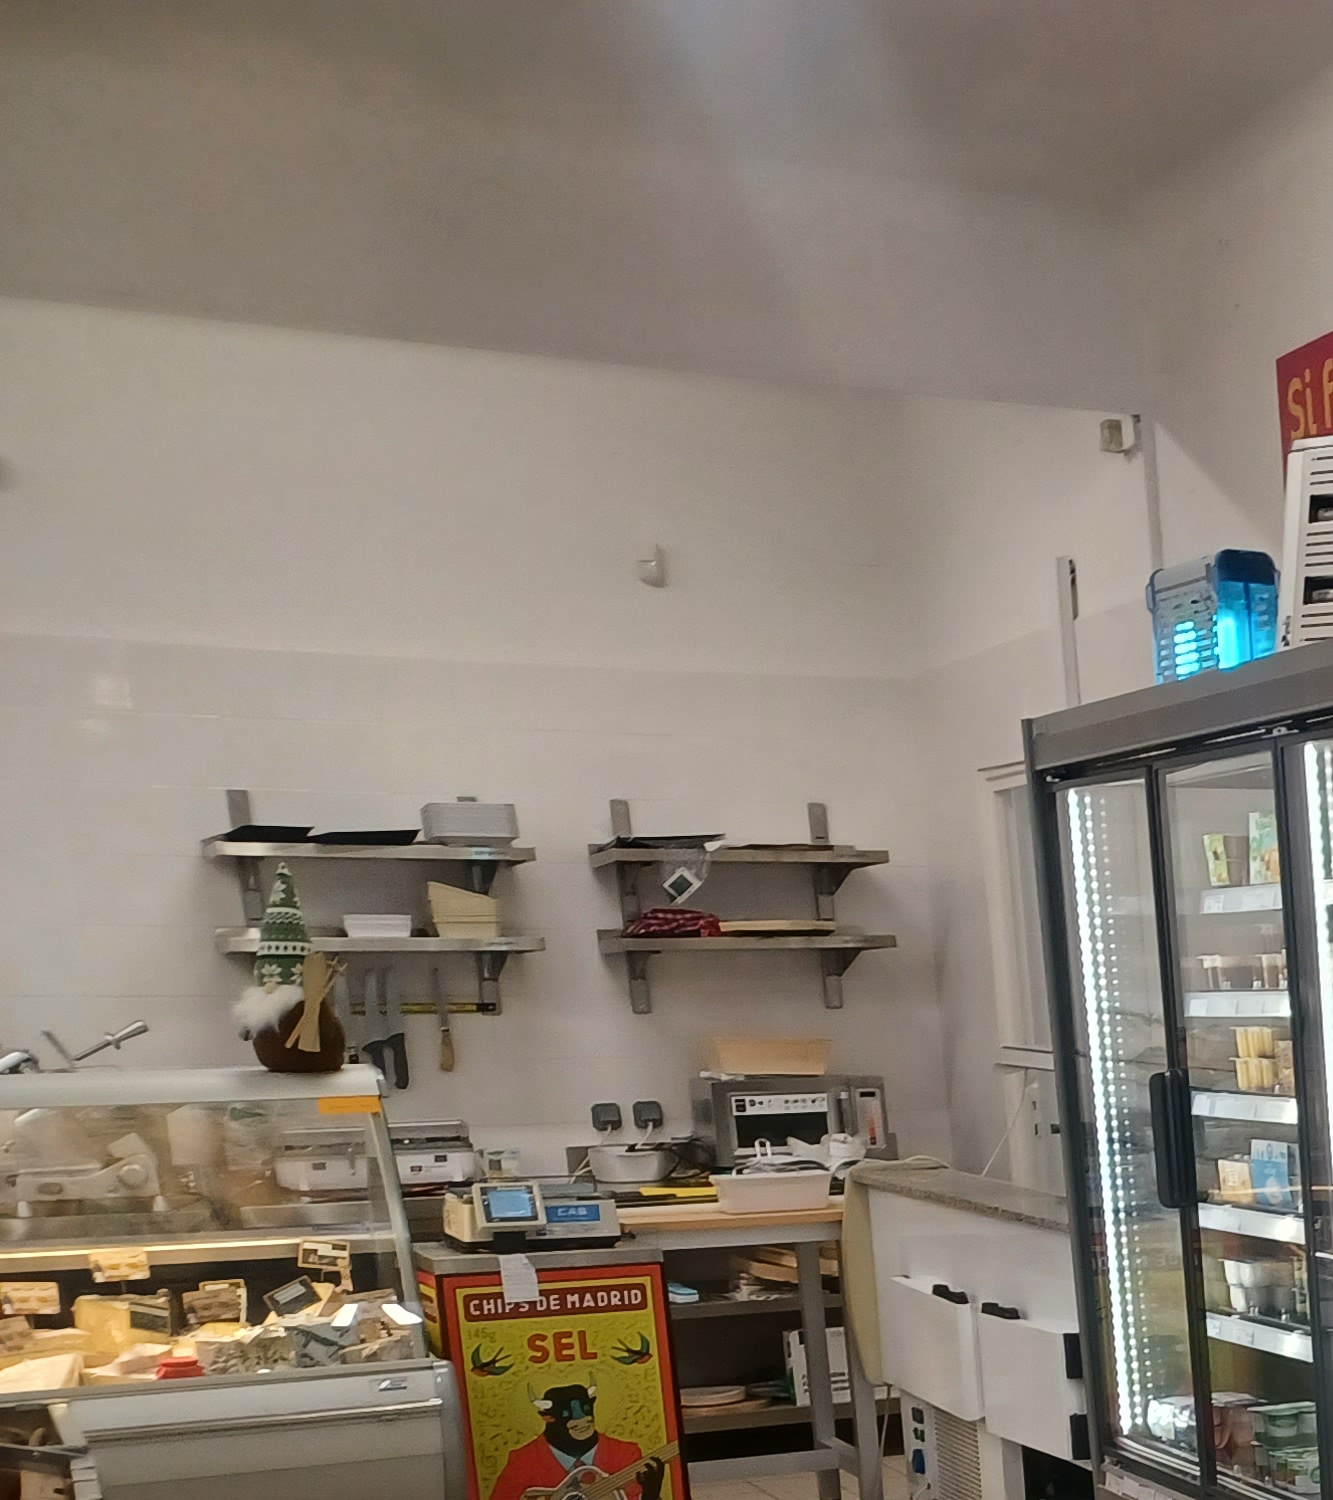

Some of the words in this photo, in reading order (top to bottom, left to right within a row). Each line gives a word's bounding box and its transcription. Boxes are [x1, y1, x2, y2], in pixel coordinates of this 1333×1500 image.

[1287, 368, 1317, 440] Si
[469, 1297, 530, 1317] CHIPS
[536, 1294, 561, 1312] DE
[566, 1288, 642, 1309] MADRID
[527, 1329, 598, 1364] SEL
